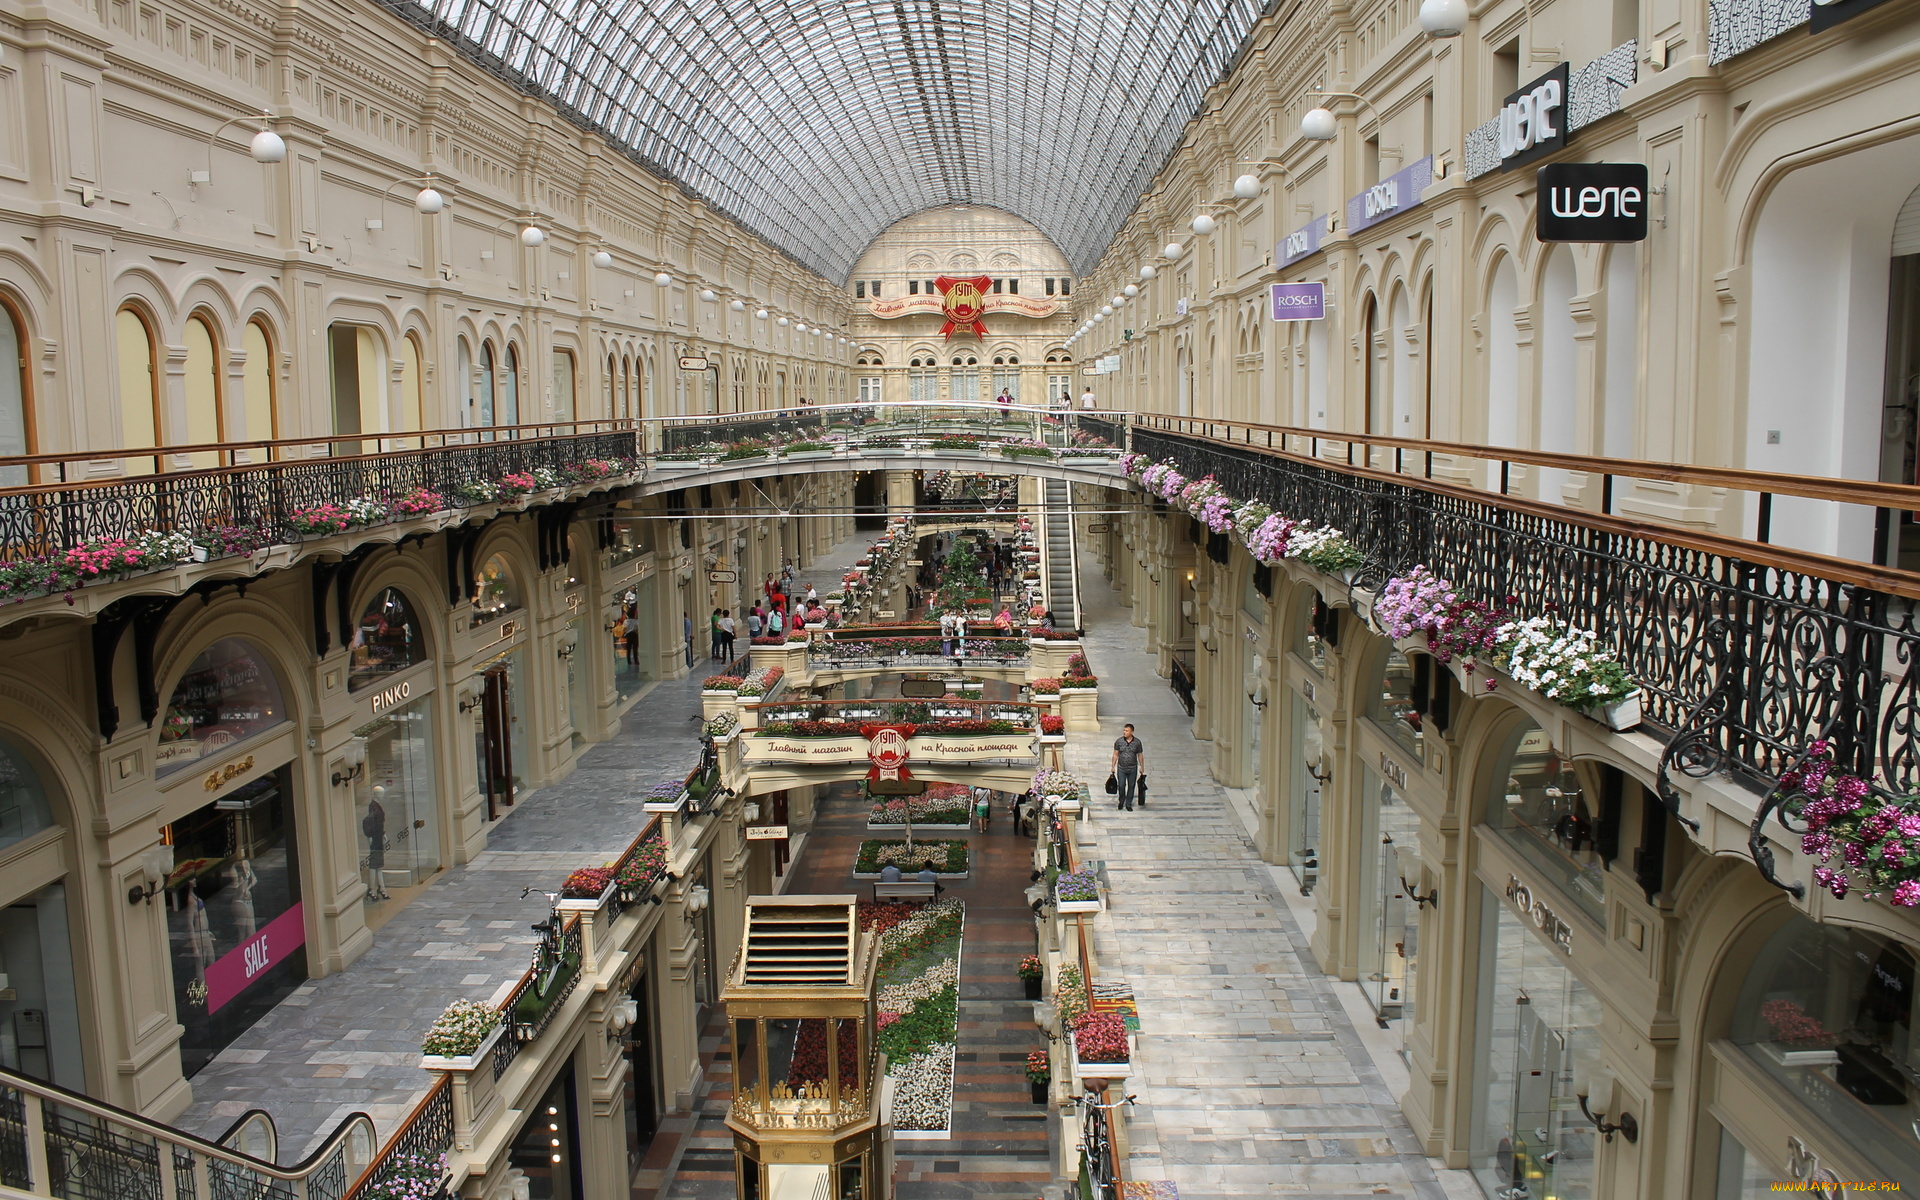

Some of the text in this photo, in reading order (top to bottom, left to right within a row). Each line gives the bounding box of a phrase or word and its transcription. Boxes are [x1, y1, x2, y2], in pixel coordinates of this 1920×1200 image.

[996, 298, 1024, 309] Красной
[1278, 295, 1318, 306] RÖSCH
[371, 681, 411, 714] PINKO
[768, 741, 808, 754] Главный
[812, 745, 853, 754] магазин
[935, 742, 976, 757] Красной
[977, 744, 1018, 754] площади
[244, 934, 269, 979] SALE
